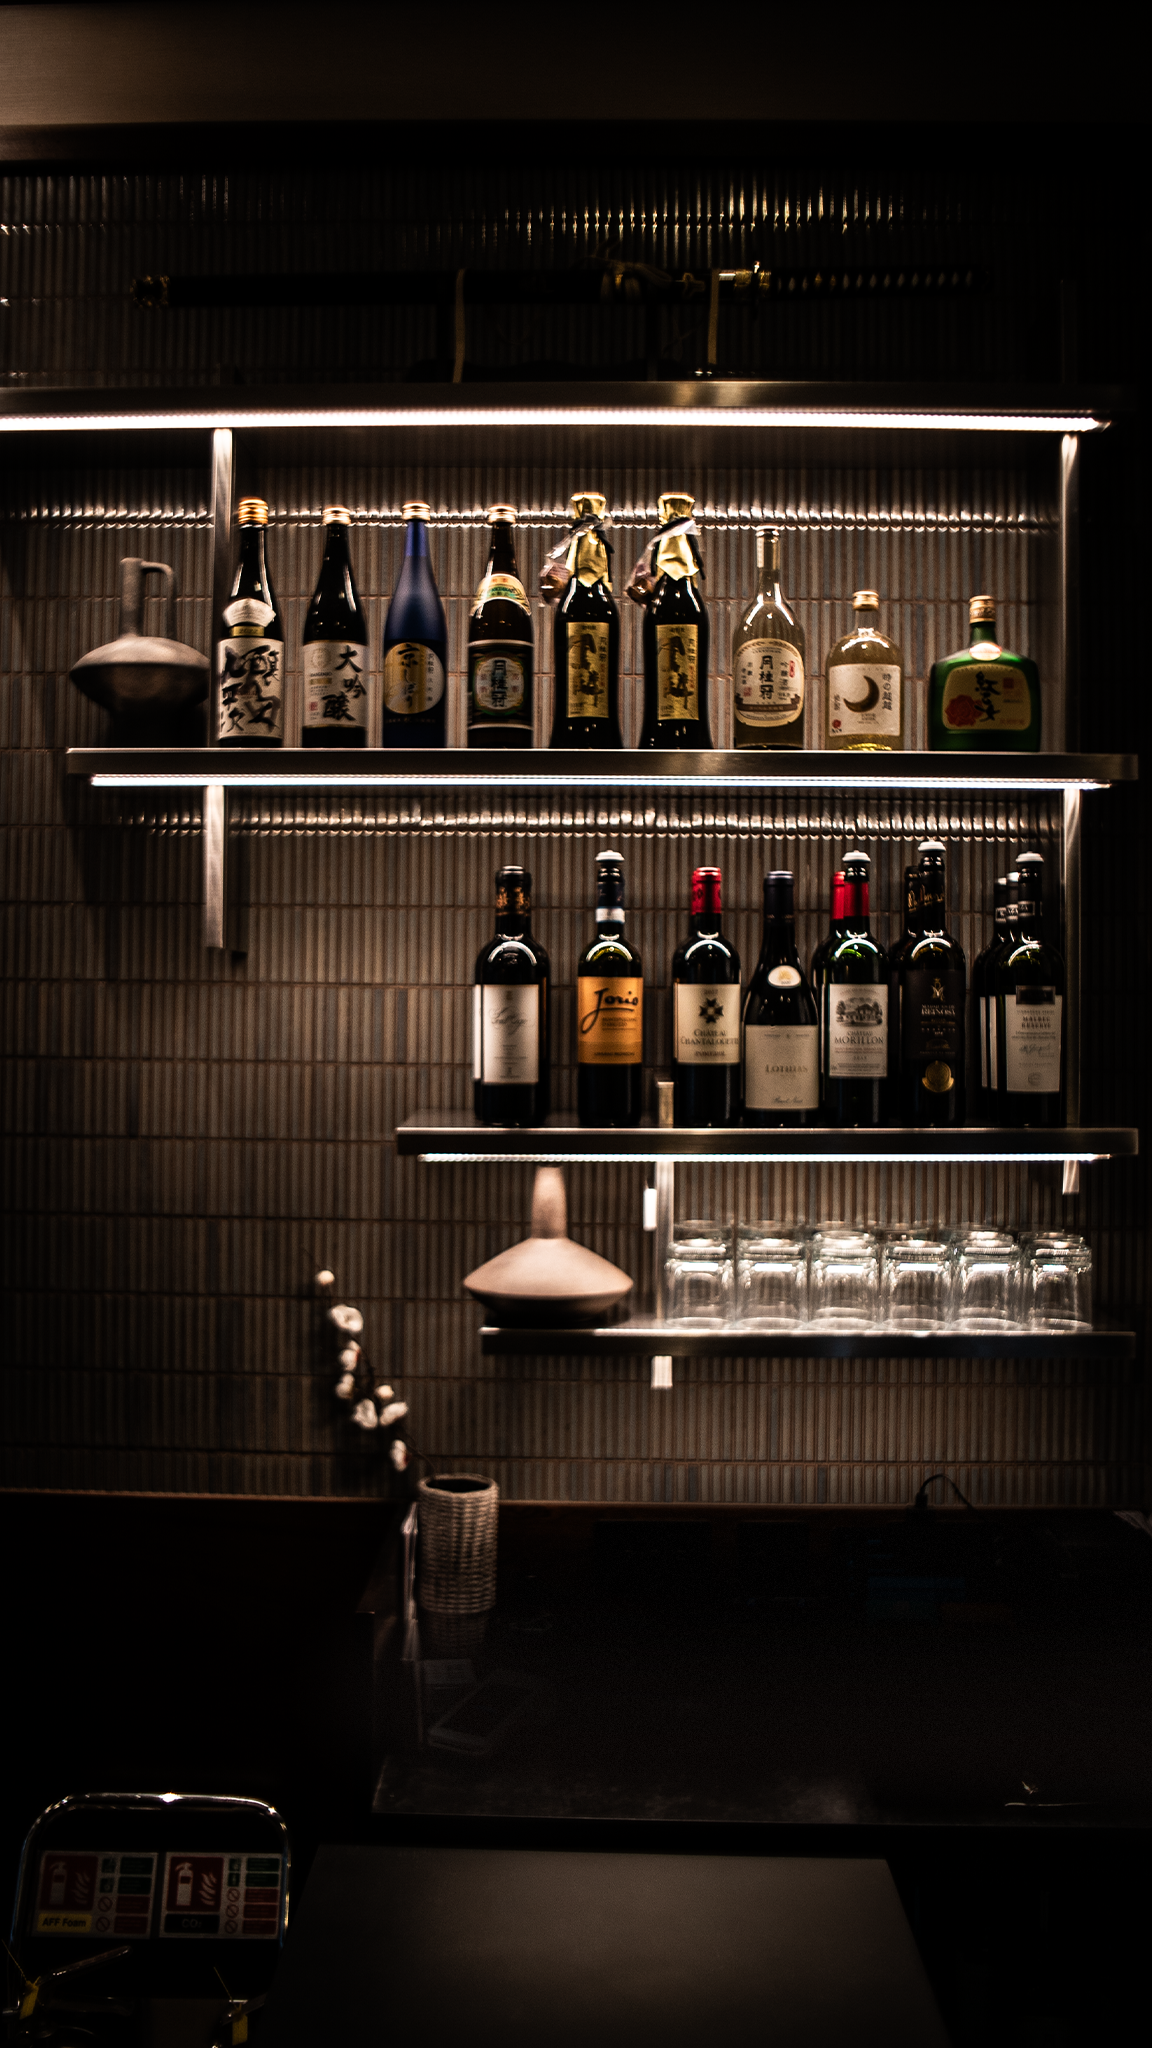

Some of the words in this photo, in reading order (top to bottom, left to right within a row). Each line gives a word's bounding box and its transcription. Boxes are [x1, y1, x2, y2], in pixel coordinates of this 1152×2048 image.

[322, 644, 367, 721] 大吟醸
[759, 655, 774, 700] 月桂冠
[834, 1035, 884, 1045] MORILLON
[41, 1916, 60, 1928] AFF
[62, 1916, 87, 1929] Foam
